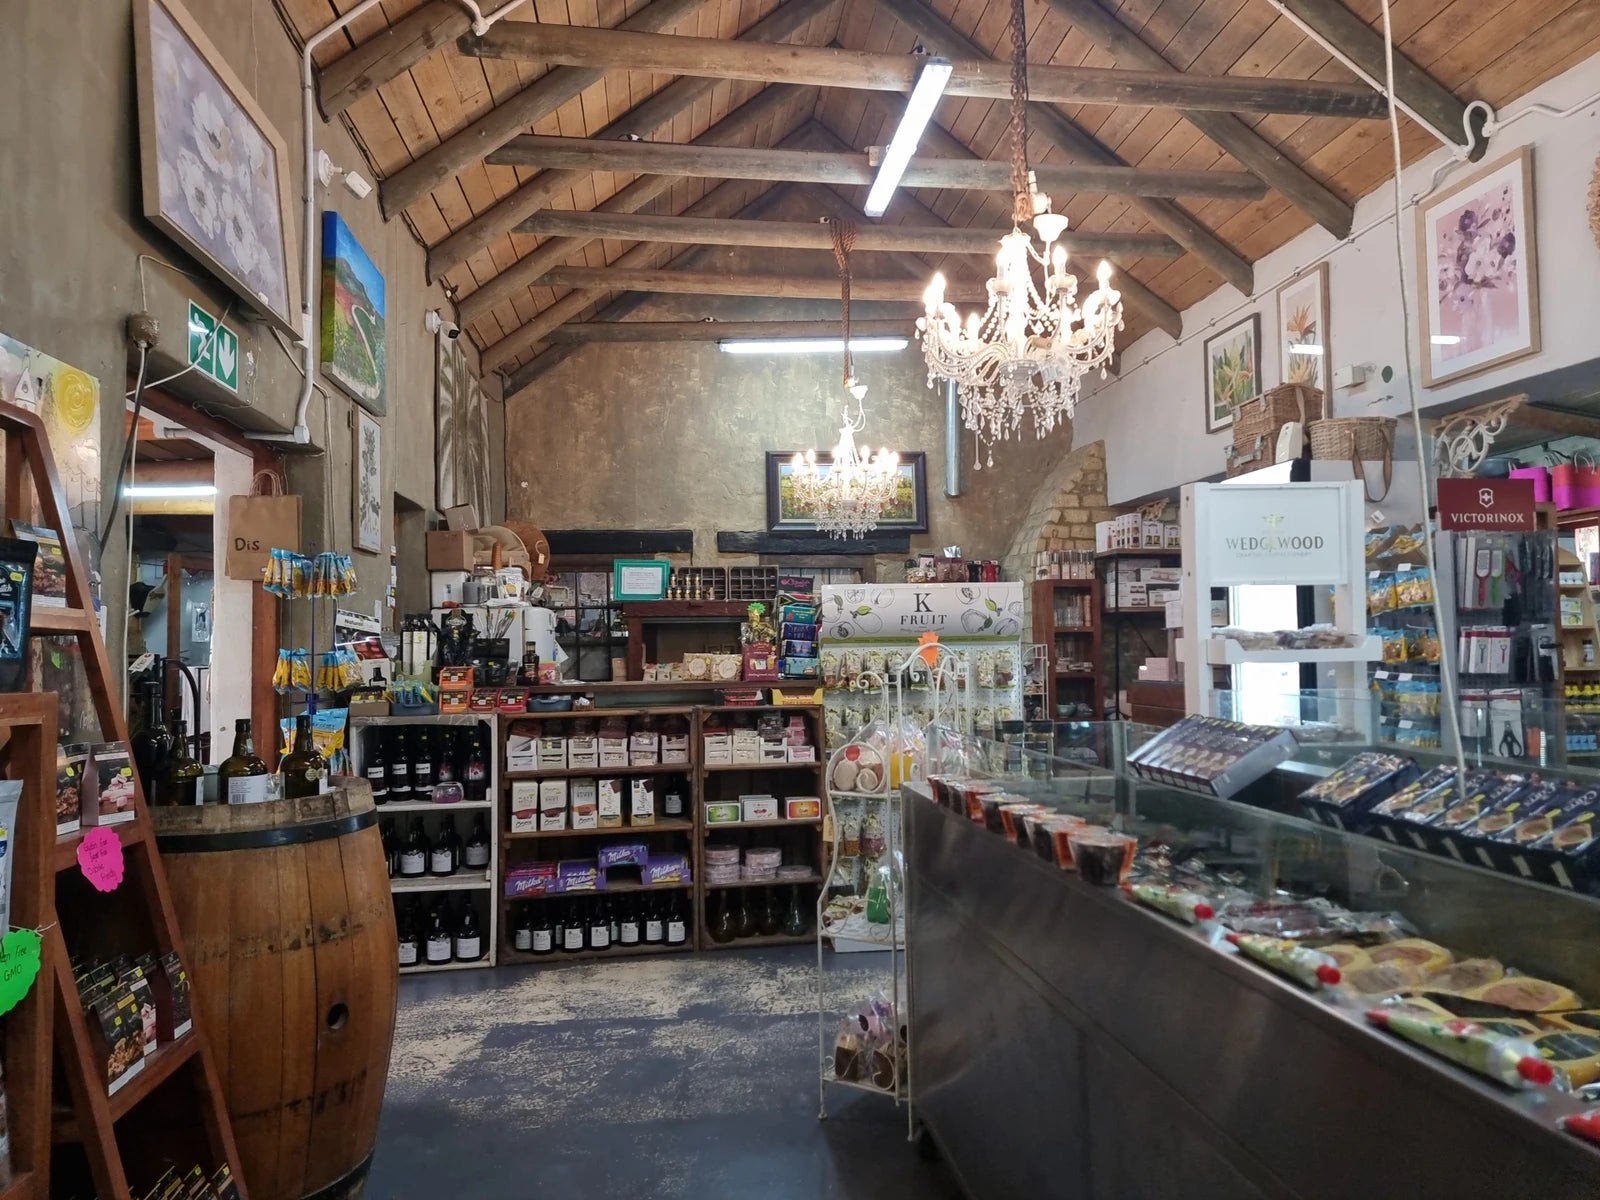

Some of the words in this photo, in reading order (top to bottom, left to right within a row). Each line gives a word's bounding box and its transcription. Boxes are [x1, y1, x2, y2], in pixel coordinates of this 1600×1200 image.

[1450, 512, 1525, 524] VICTORINOX
[234, 537, 260, 551] Dis
[913, 592, 933, 613] K
[900, 614, 948, 625] FRUIT
[608, 849, 631, 862] Milka
[649, 864, 676, 878] Milka
[515, 878, 541, 891] Milka
[3, 963, 23, 982] GMO
